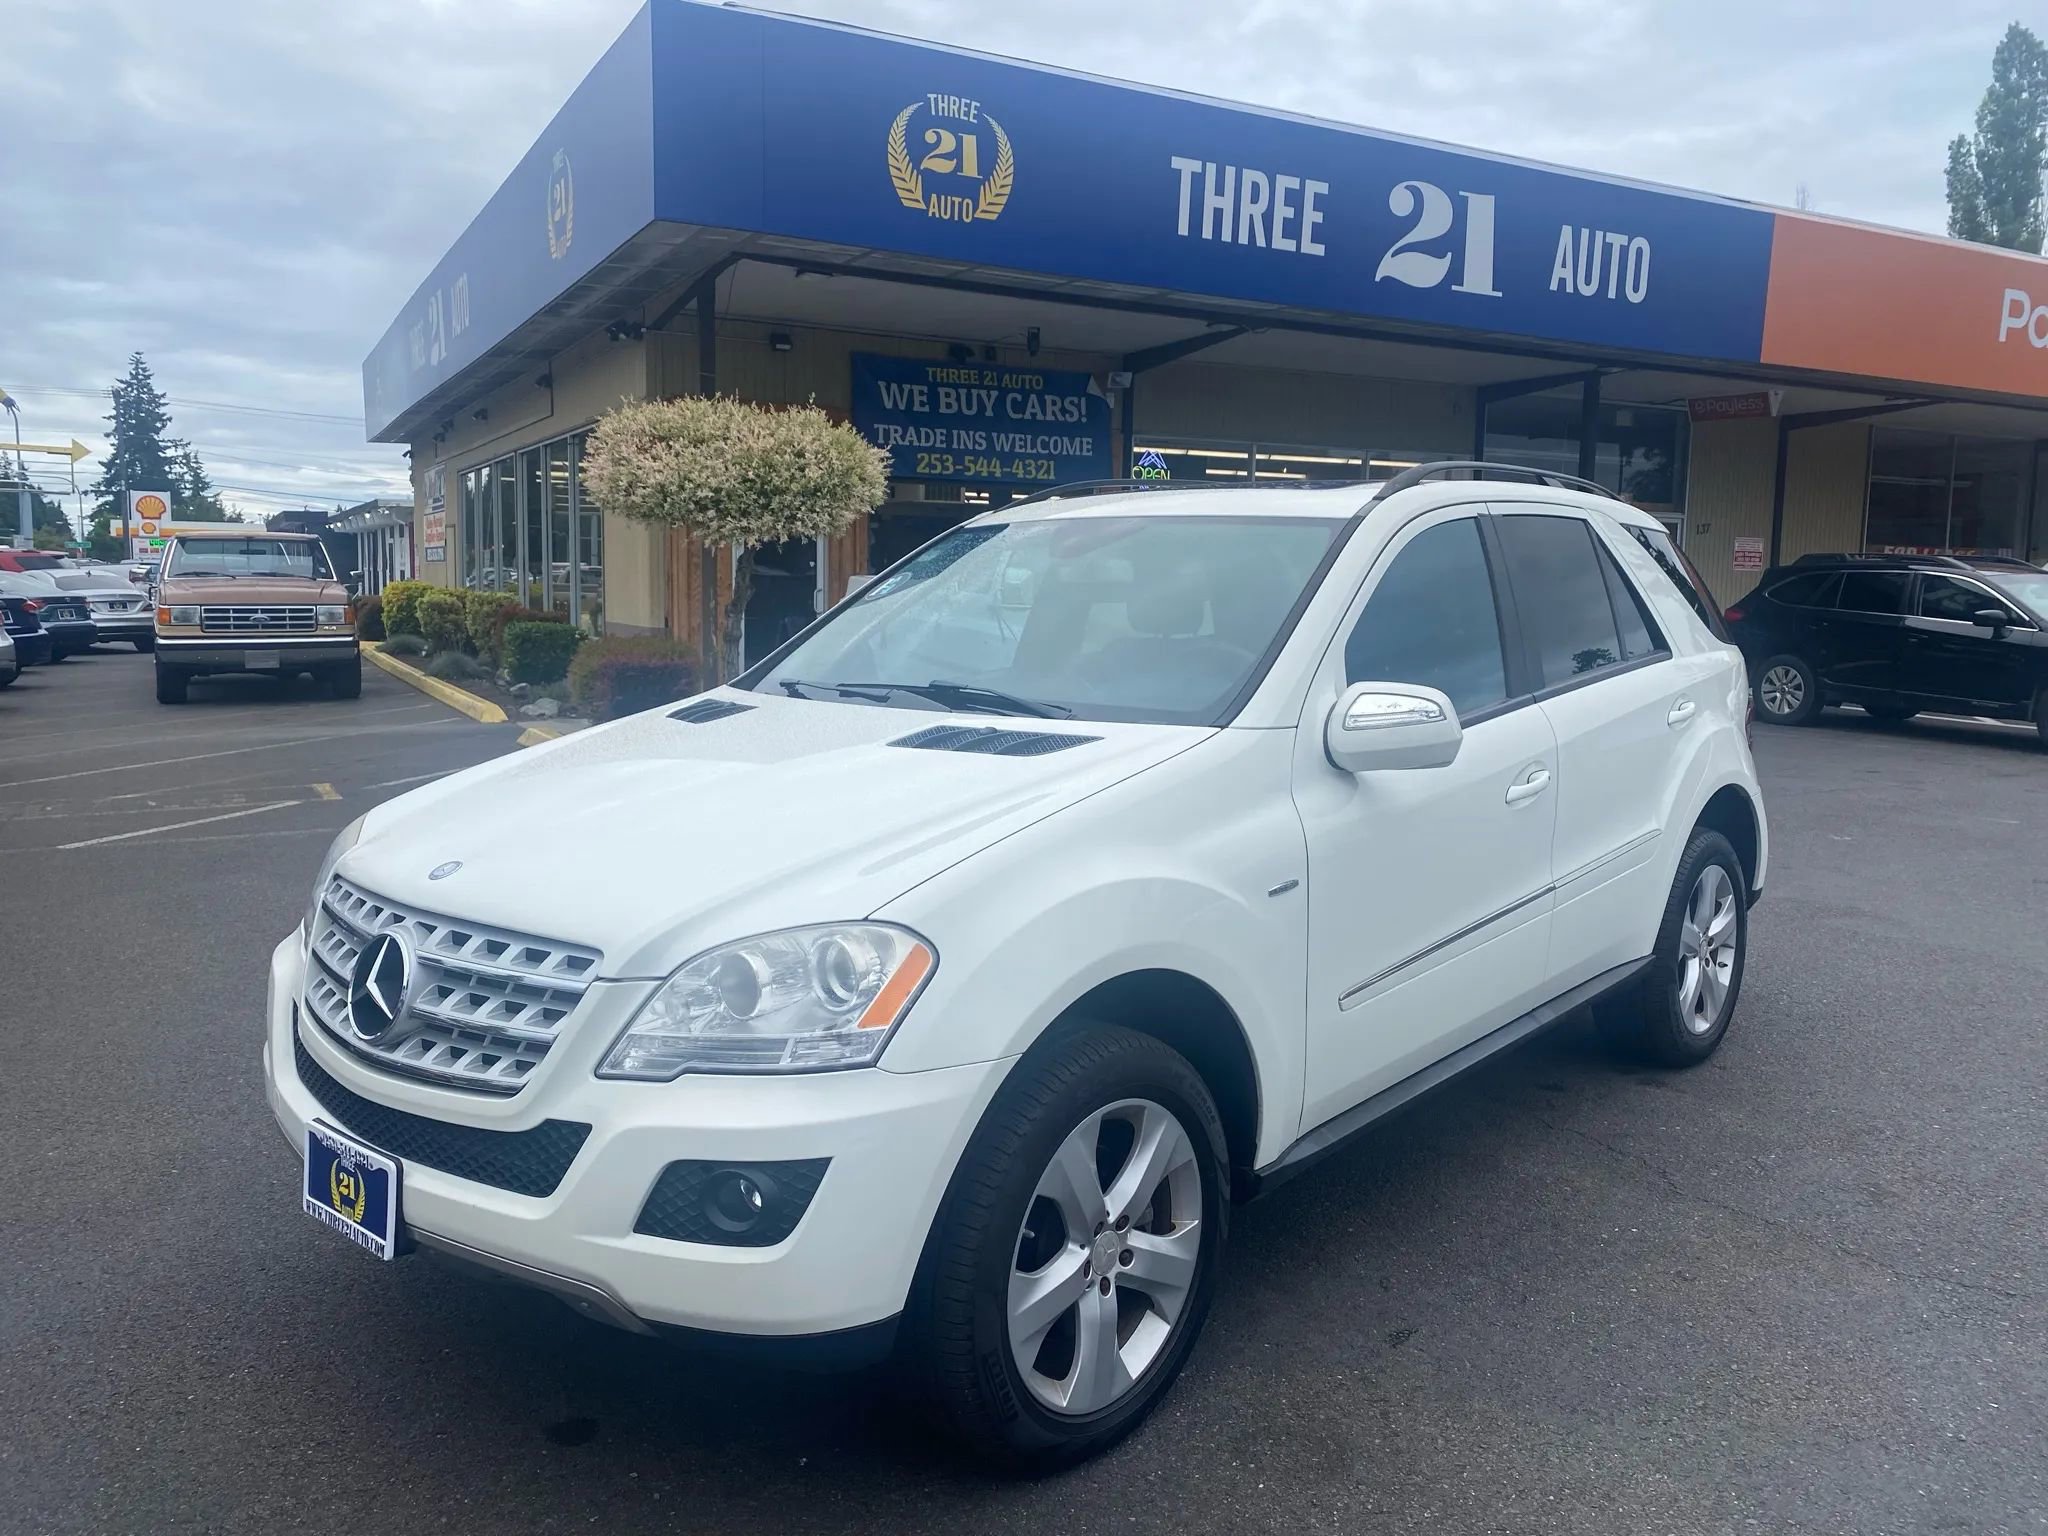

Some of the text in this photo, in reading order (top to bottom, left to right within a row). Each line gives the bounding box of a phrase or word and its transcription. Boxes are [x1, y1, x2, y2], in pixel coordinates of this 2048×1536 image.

[927, 94, 981, 124] THREE
[920, 128, 983, 179] 21
[928, 193, 973, 223] AUTO
[1170, 156, 1651, 304] THREE 21 AUTO
[428, 288, 447, 366] 21
[926, 367, 1044, 390] THREE 21 AUTO
[877, 380, 1088, 423] WE BUY CARS!
[1707, 398, 1764, 417] Payless
[874, 423, 1094, 457] TRADE INS WELCOME
[916, 452, 1057, 481] 253-544-4321
[1132, 466, 1171, 480] OPEN
[1696, 523, 1711, 536] 137
[339, 1172, 357, 1200] 21
